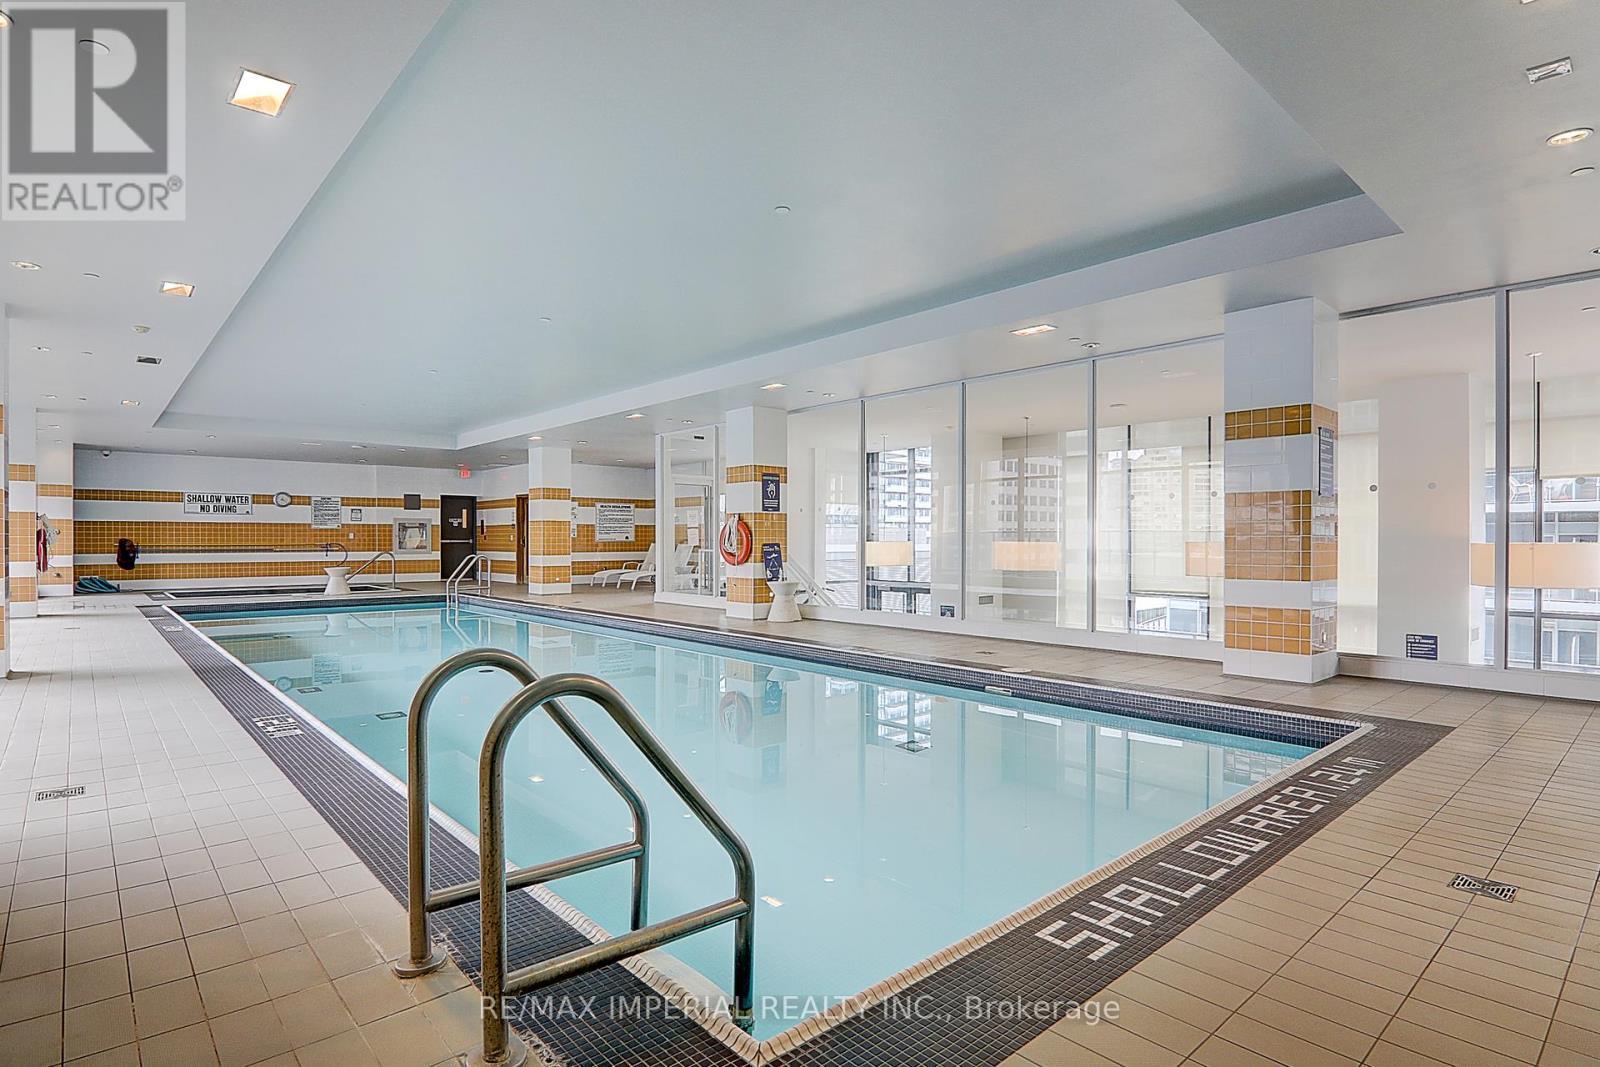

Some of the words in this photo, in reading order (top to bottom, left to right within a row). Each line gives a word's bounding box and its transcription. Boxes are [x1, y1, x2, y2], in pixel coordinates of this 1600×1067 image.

[187, 494, 222, 503] SHALLOW
[225, 496, 250, 504] WATER
[200, 504, 211, 513] NO
[213, 505, 237, 513] DIVING
[1035, 828, 1270, 961] SHALLOW
[1230, 786, 1330, 835] AREA
